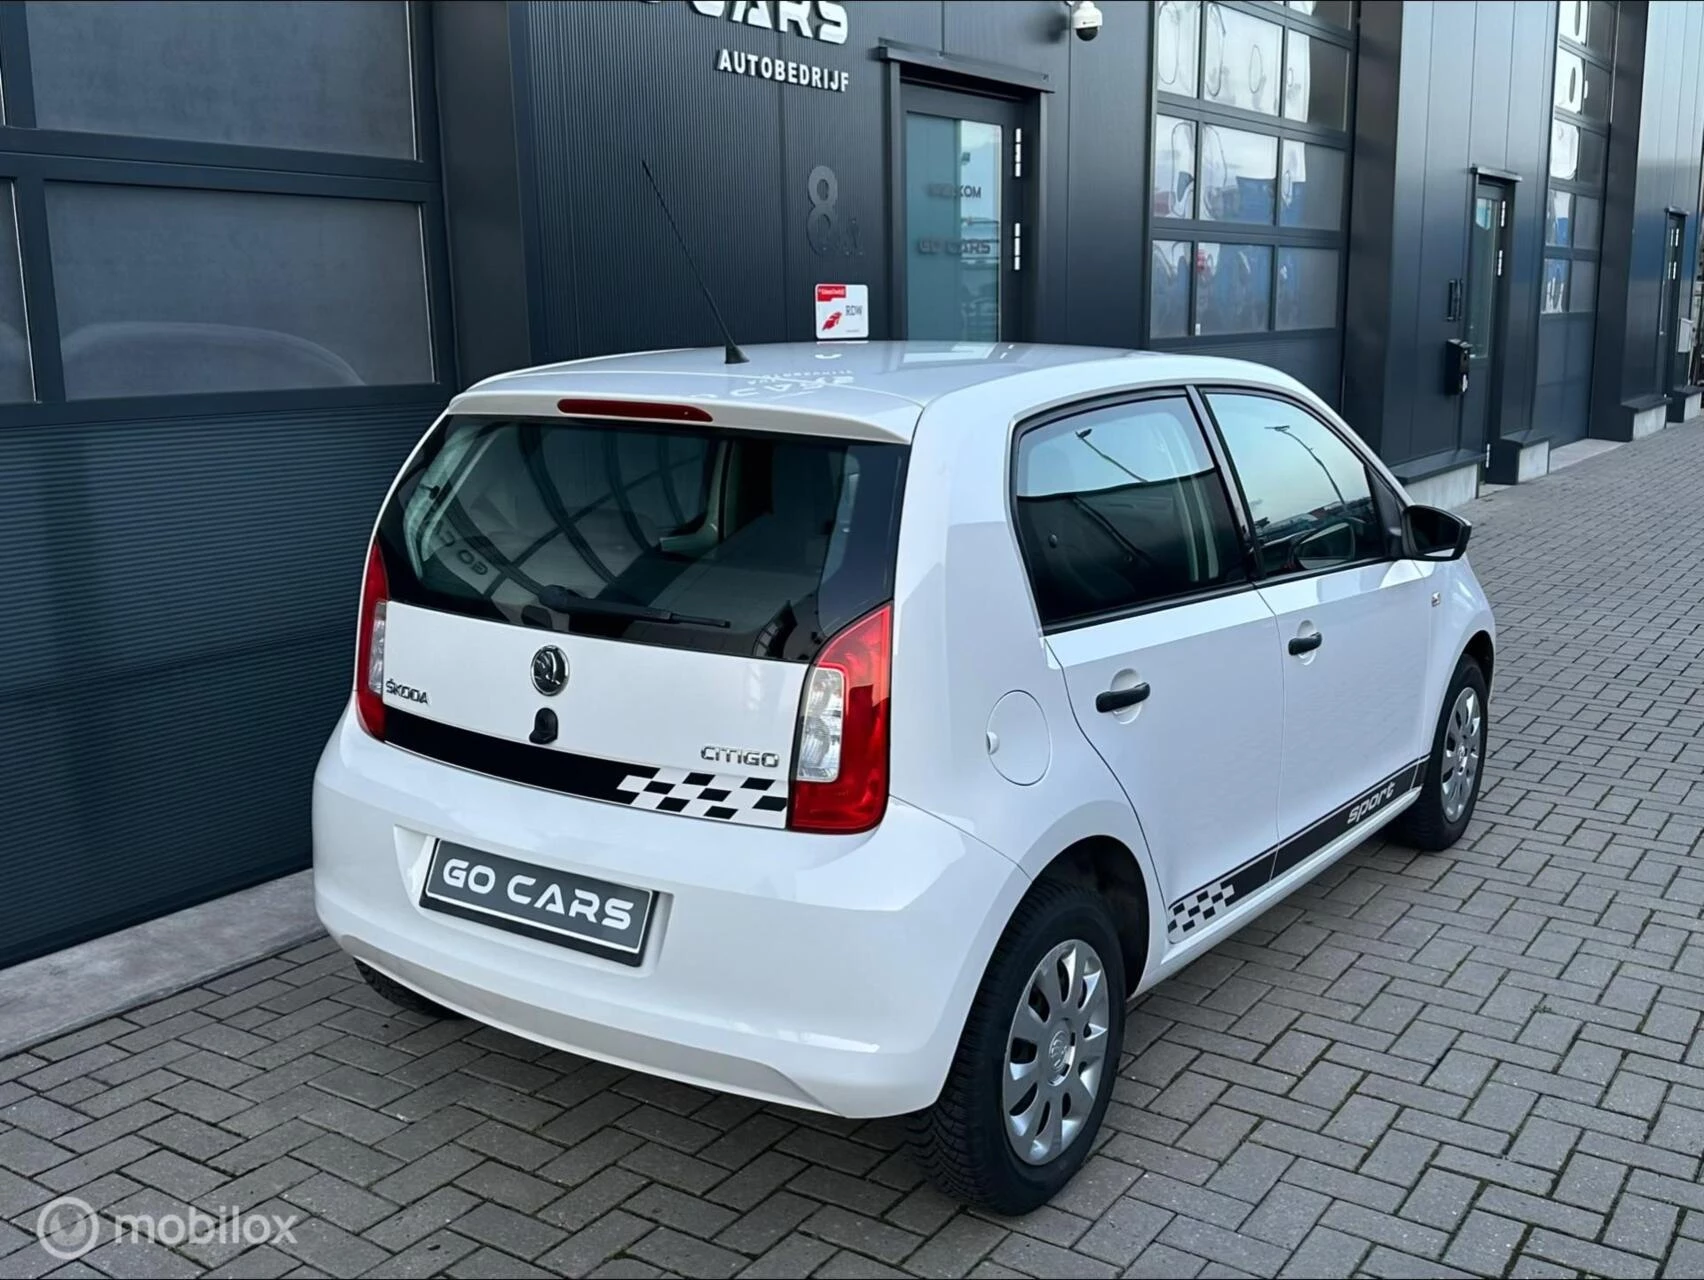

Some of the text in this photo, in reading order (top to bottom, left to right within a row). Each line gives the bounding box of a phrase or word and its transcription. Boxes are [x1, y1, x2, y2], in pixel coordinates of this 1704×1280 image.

[717, 48, 849, 92] AUTOBEDRIJF
[385, 678, 429, 704] ŠKODA
[700, 746, 779, 768] CITIGO
[1347, 781, 1396, 824] sport
[442, 858, 635, 930] GO CARS
